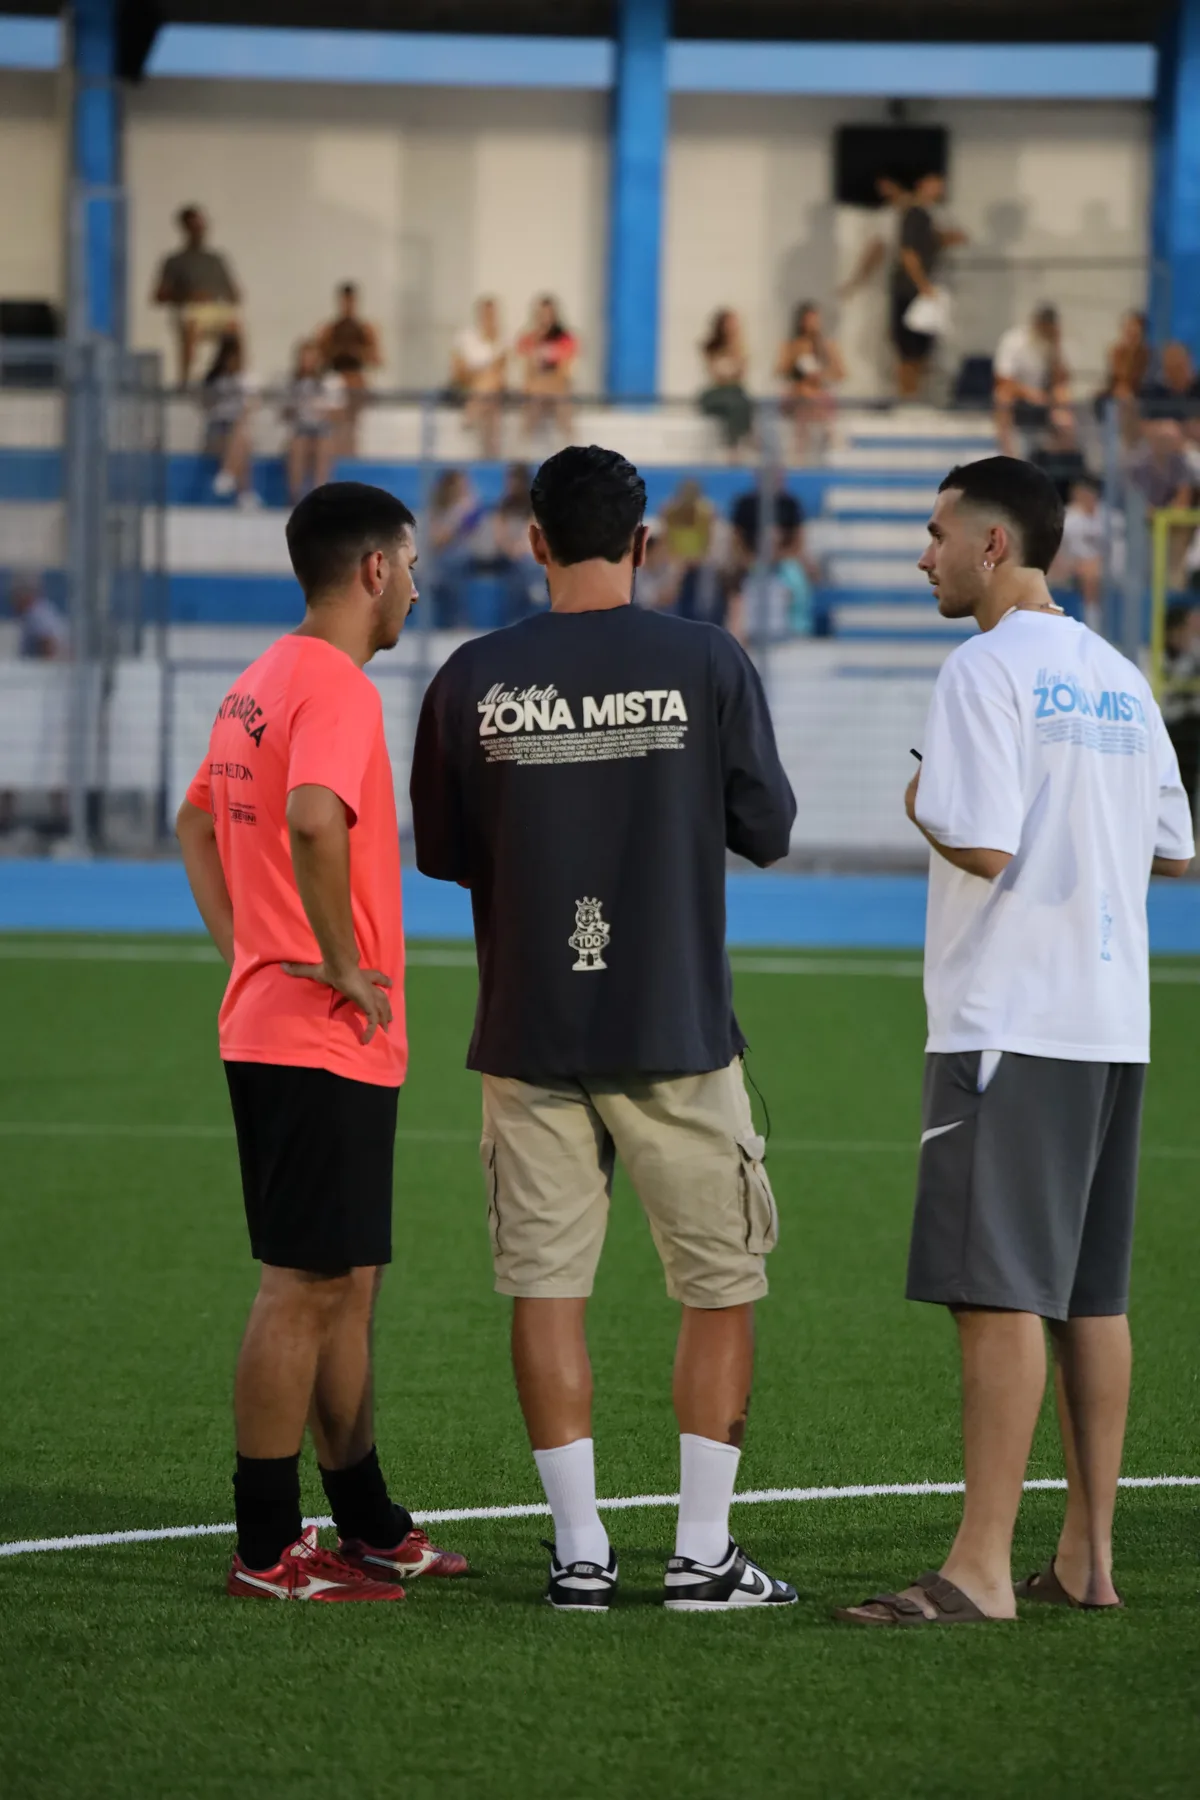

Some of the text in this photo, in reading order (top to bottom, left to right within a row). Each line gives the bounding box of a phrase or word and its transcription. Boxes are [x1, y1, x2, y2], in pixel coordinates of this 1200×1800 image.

[478, 683, 558, 705] Mai stato
[1033, 684, 1094, 718] ZO
[478, 690, 688, 736] ZONA MISTA
[573, 1563, 595, 1574] NIKE
